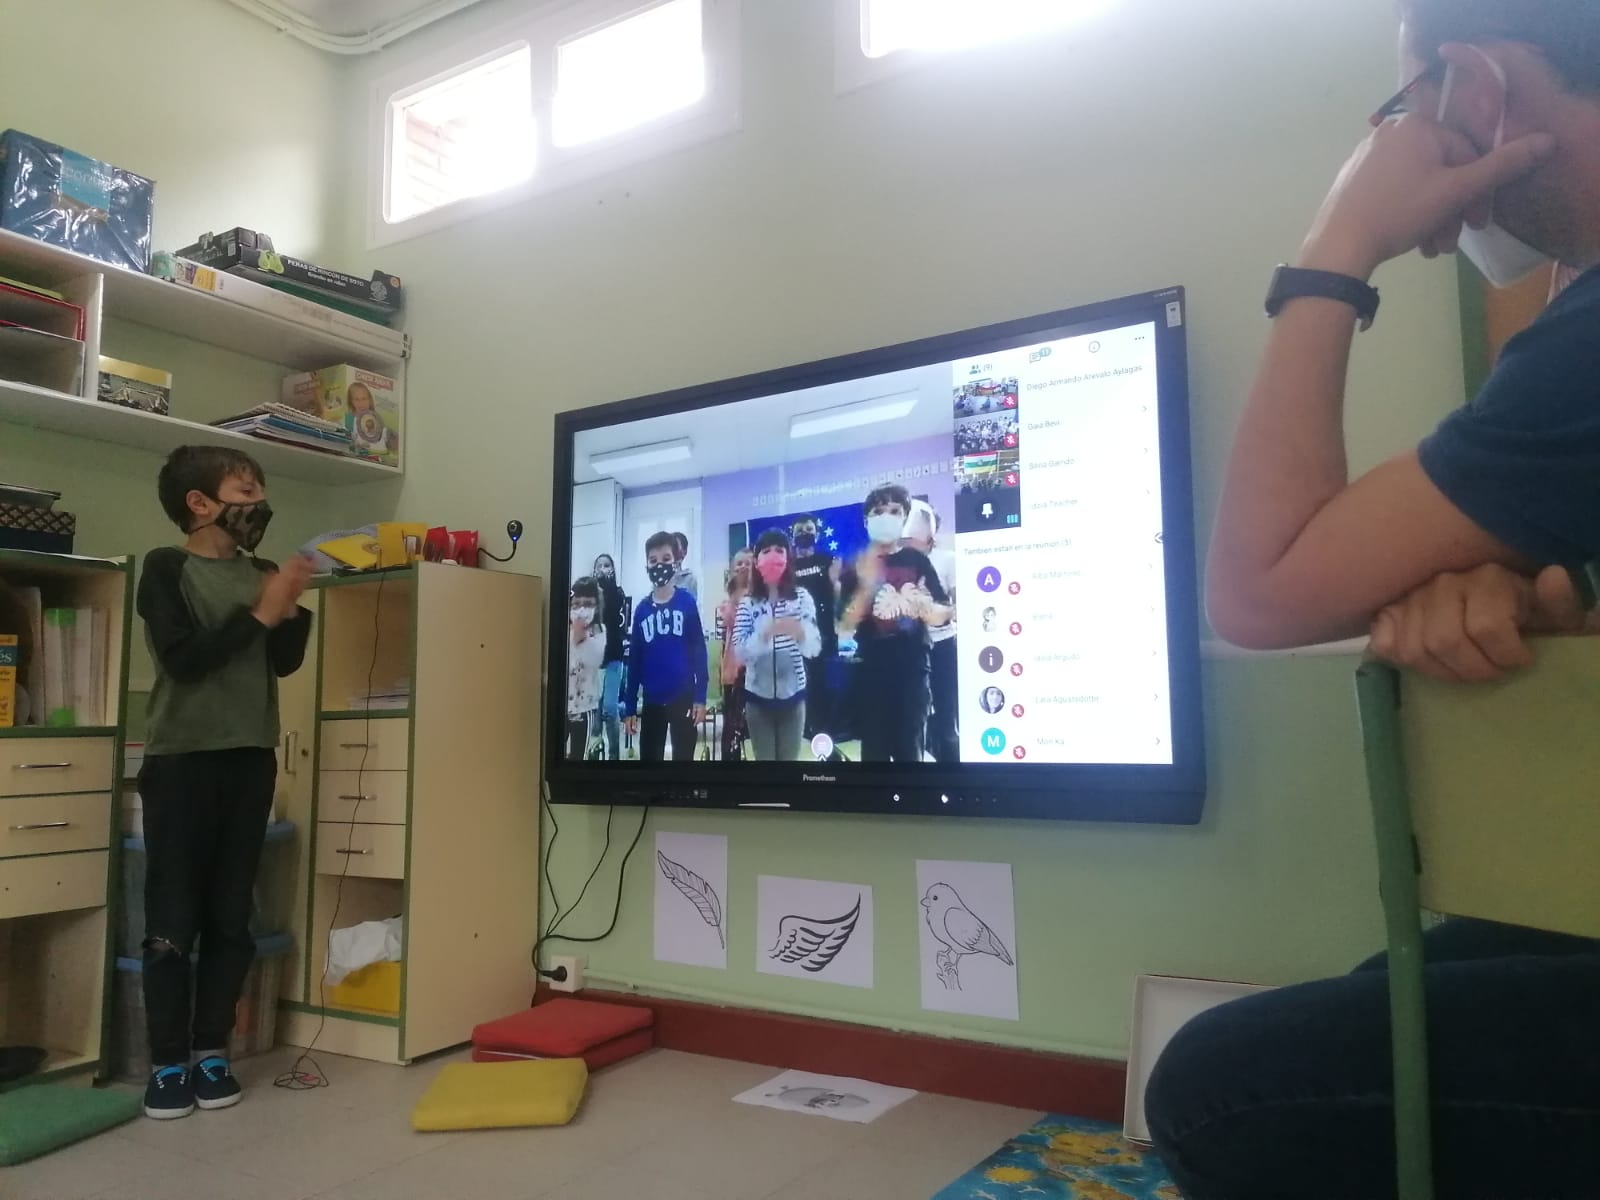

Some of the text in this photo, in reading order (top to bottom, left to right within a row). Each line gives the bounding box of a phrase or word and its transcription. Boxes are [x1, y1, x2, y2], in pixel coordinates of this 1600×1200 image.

[1049, 376, 1082, 386] Armando
[984, 574, 994, 586] A
[641, 608, 684, 643] UCB
[987, 736, 999, 748] M
